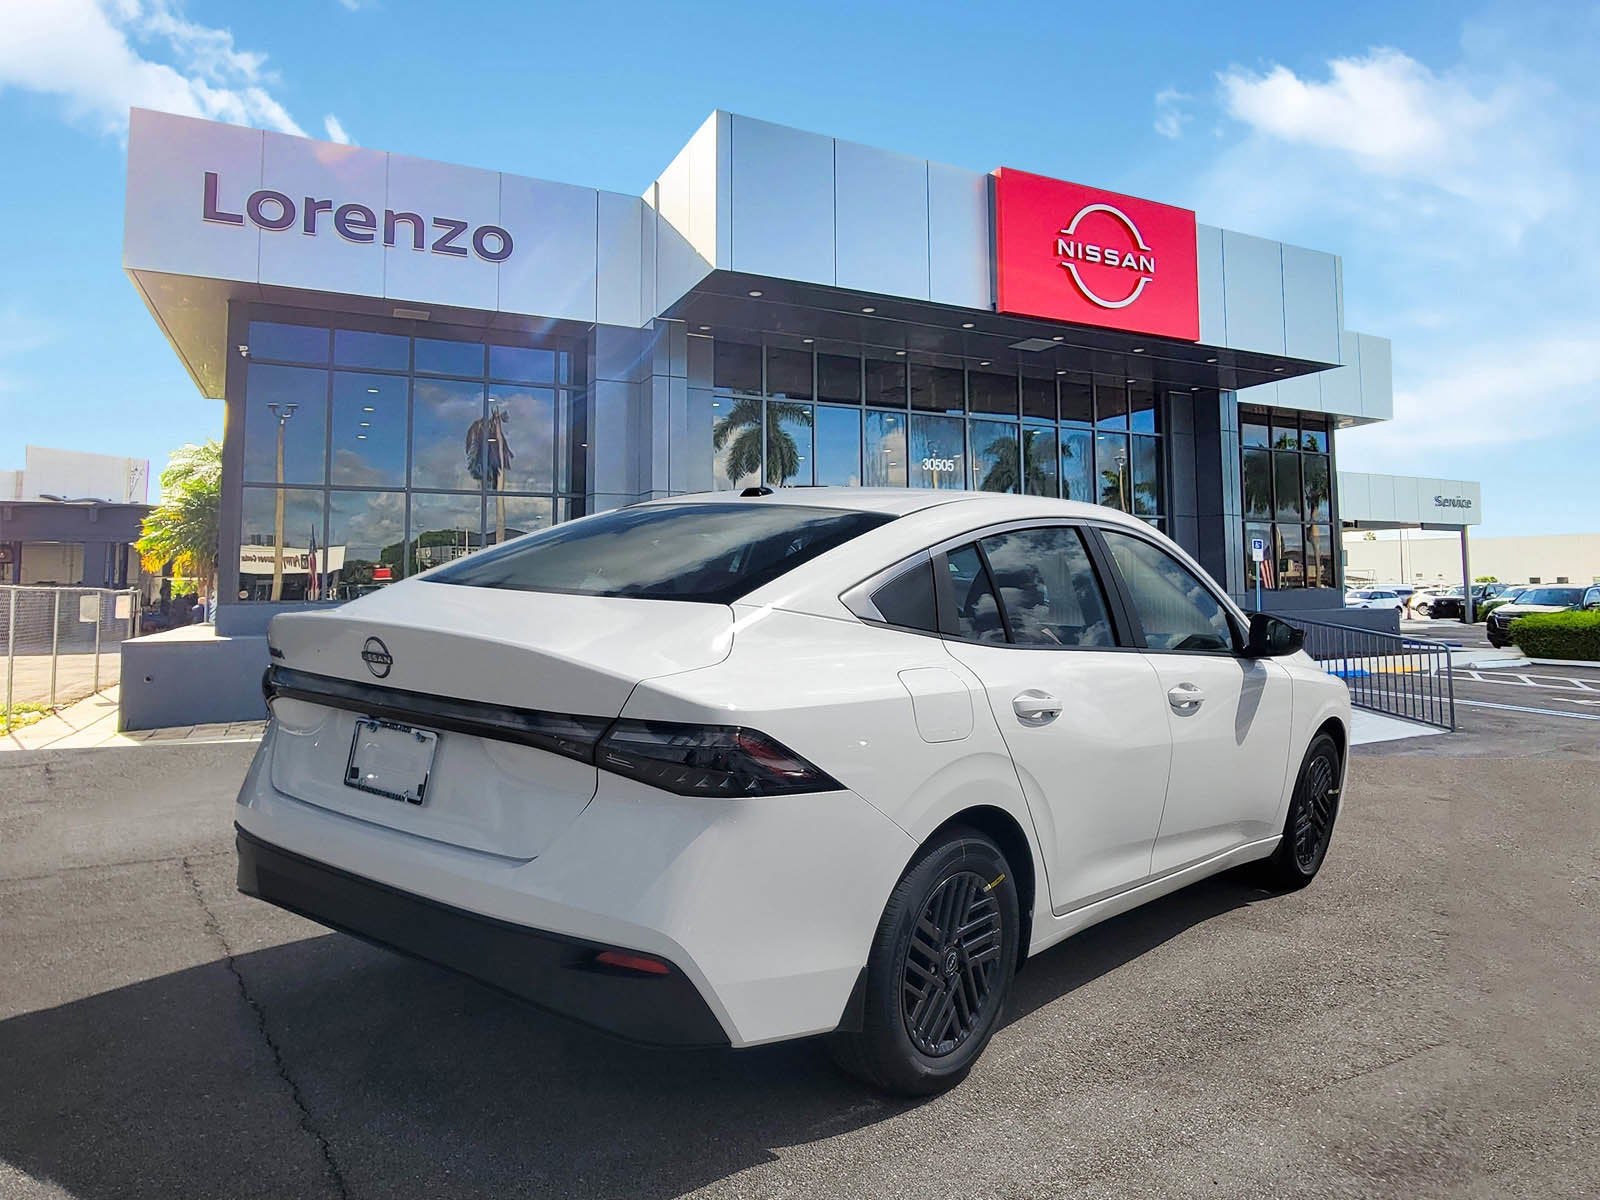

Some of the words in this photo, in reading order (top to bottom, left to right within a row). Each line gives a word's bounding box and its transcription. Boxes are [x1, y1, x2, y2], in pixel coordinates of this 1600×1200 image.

[203, 171, 514, 262] Lorenzo
[1057, 238, 1155, 273] NISSAN
[922, 457, 954, 471] 30505
[1433, 495, 1472, 509] Service
[362, 652, 392, 664] SSAN
